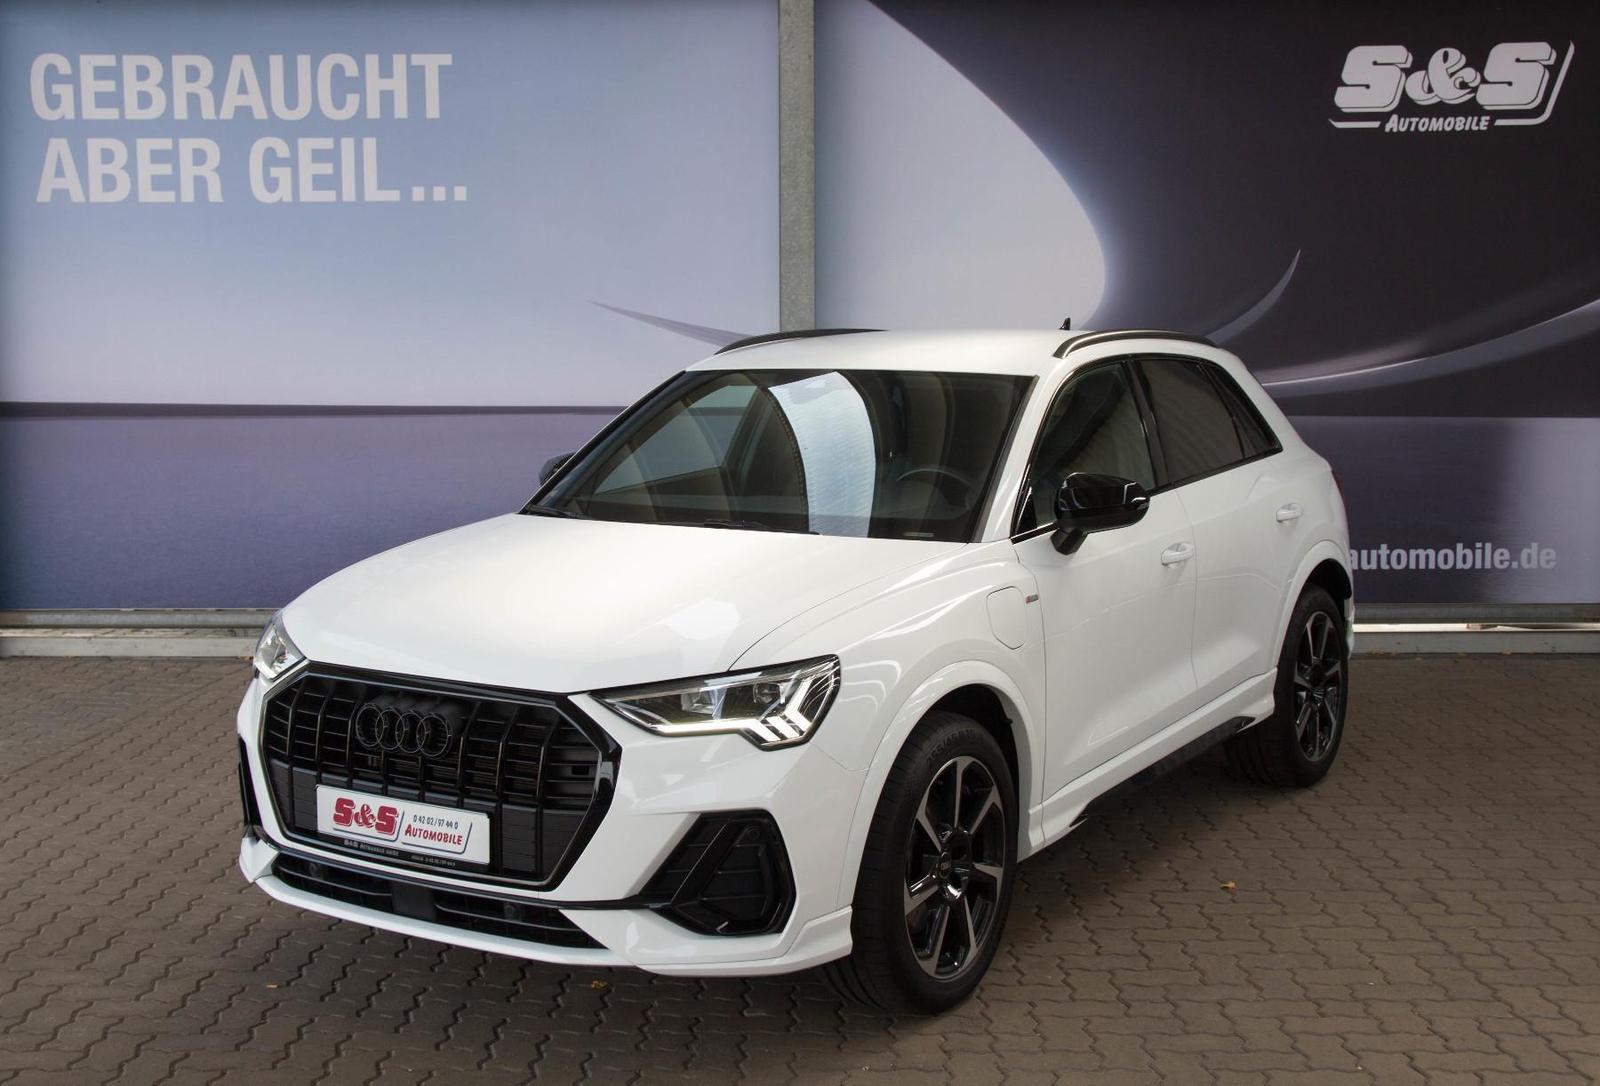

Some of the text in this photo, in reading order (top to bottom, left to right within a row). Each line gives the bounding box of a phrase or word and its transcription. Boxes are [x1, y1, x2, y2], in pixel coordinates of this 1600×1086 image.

[30, 53, 453, 121] GEBRAUCHT
[1334, 41, 1557, 113] S&S
[1385, 114, 1490, 132] AUTOMOBILE
[36, 138, 223, 203] ABER
[333, 797, 399, 836] S&S
[404, 824, 463, 846] AUTOMOBILE
